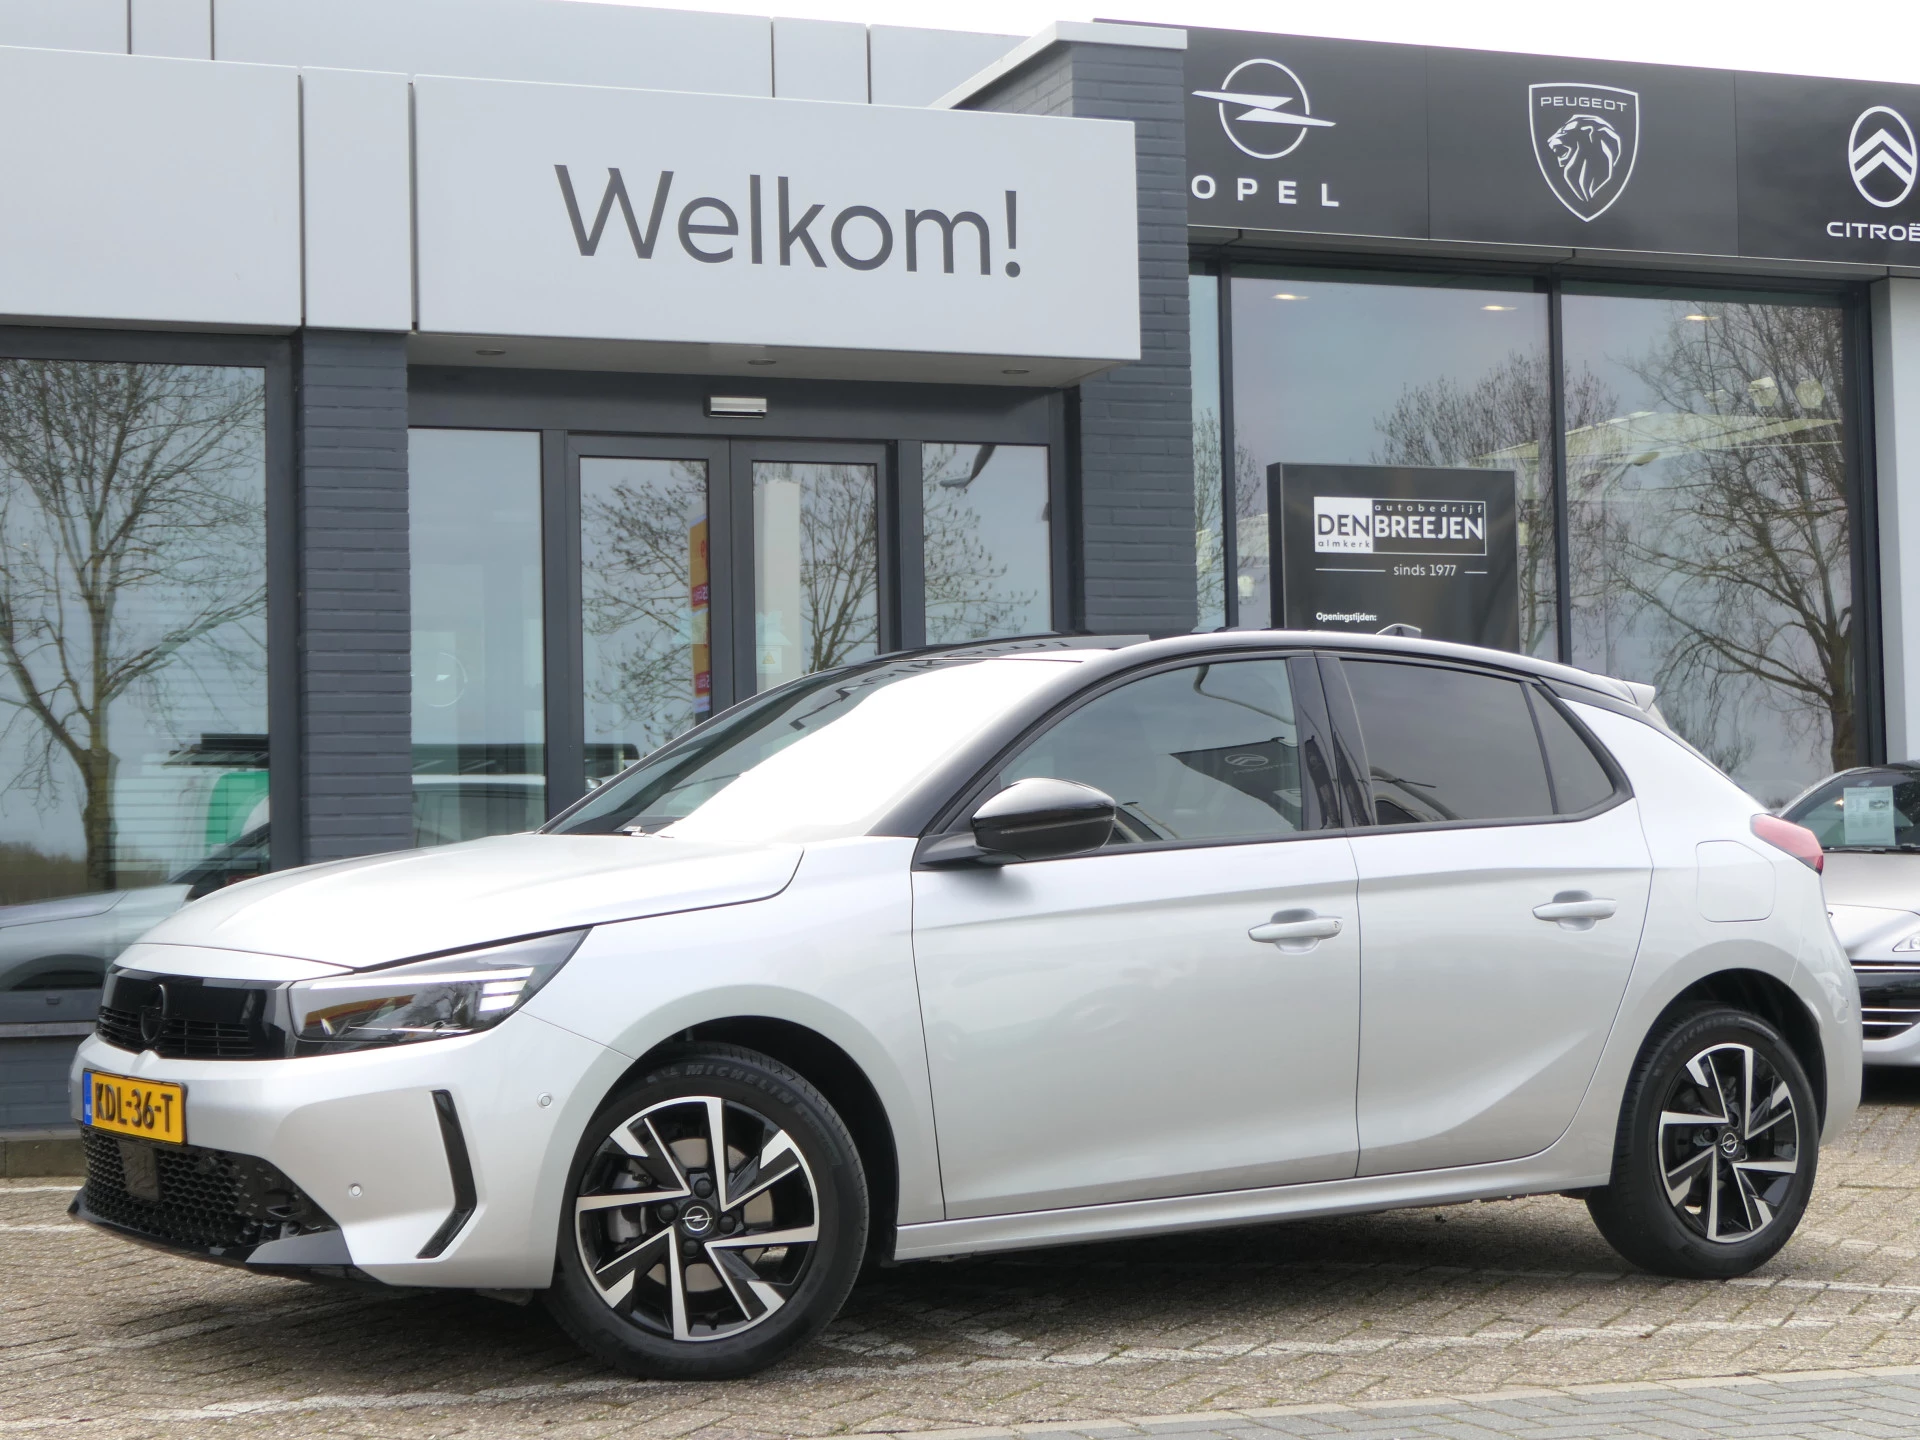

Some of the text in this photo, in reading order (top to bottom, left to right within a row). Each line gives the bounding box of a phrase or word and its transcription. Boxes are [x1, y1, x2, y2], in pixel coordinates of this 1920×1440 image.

[1540, 96, 1628, 112] PEUGEOT
[1191, 174, 1339, 207] OPEL
[554, 164, 1021, 278] Welkom!
[1826, 221, 1920, 242] CITROË
[1374, 503, 1483, 515] autobedrijf
[1317, 514, 1484, 540] DEN BREEJEN
[1318, 539, 1370, 548] almkerk
[1393, 564, 1457, 577] sinds 1977
[1316, 612, 1377, 623] Openingstijden:
[685, 1064, 795, 1104] MICHELIN
[95, 1082, 173, 1133] KDL-36-T
